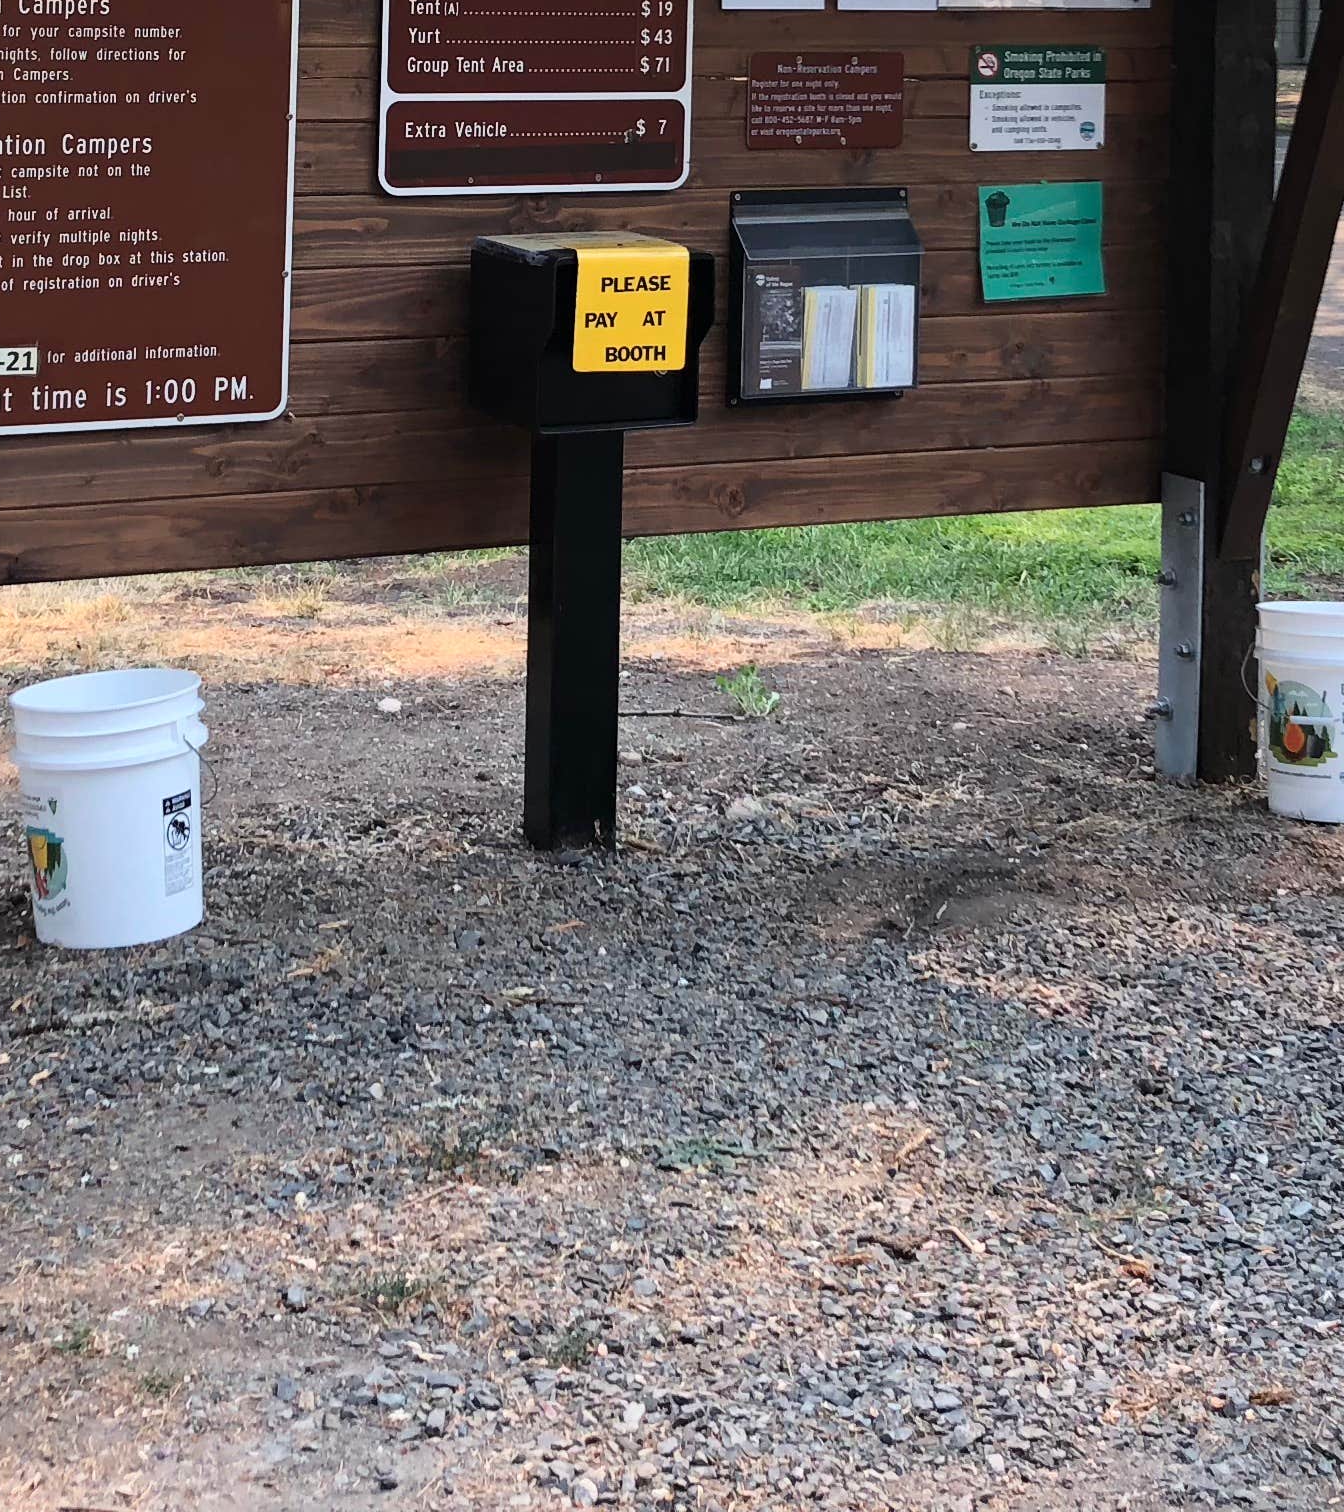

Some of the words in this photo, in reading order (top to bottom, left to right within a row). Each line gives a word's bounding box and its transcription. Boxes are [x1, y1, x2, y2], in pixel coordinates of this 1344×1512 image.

[409, 0, 440, 15] Tent
[444, 2, 459, 16] (A)
[641, 0, 651, 18] $
[659, 1, 673, 16] 19
[3, 24, 21, 37] for
[30, 27, 59, 40] your
[68, 25, 125, 40] campsite
[409, 28, 440, 43] Yurt
[641, 28, 650, 46] $
[654, 29, 672, 44] 43
[50, 48, 87, 60] follow
[96, 48, 159, 61] directions
[169, 48, 186, 61] for
[1004, 51, 1044, 65] Smoking
[1046, 51, 1090, 62] Prohibited
[1093, 53, 1102, 62] in
[14, 68, 73, 83] Campers.
[407, 57, 449, 77] Group
[456, 57, 485, 72] Tent
[492, 57, 524, 72] Area
[640, 56, 649, 74] $
[655, 57, 669, 72] 71
[777, 64, 842, 74] Non-Reservation
[845, 65, 877, 75] Campers
[1003, 68, 1036, 82] Oregon
[1038, 68, 1062, 79] State
[1065, 68, 1091, 79] Parks
[35, 91, 116, 103] confirmation
[126, 93, 139, 103] on
[149, 90, 196, 103] driver's
[405, 122, 446, 138] Extra
[455, 122, 507, 137] Vehicle
[636, 119, 646, 137] $
[659, 120, 667, 134] 7
[62, 134, 152, 159] Campers
[11, 165, 69, 180] campsite
[78, 164, 98, 177] not
[107, 166, 121, 176] on
[131, 164, 150, 176] the
[3, 186, 30, 198] List.
[8, 209, 37, 221] hour
[46, 208, 58, 221] of
[10, 231, 50, 247] verify
[59, 230, 110, 245] multiple
[120, 229, 161, 245] nights.
[12, 255, 23, 267] in
[33, 254, 53, 267] the
[62, 253, 89, 268] drop
[99, 253, 120, 265] box
[129, 251, 141, 264] at
[151, 251, 174, 264] this
[182, 250, 228, 266] station.
[1, 278, 14, 291] of
[23, 275, 99, 294] registration
[108, 274, 122, 288] on
[131, 272, 180, 287] driver's
[600, 273, 672, 294] PLEASE
[584, 311, 618, 330] PAY
[643, 310, 666, 327] AT
[48, 351, 65, 363] for
[74, 347, 136, 362] additional
[145, 344, 219, 359] information.
[604, 345, 668, 363] BOOTH
[32, 385, 87, 410] time
[107, 382, 126, 409] is
[146, 378, 195, 404] 1:00
[215, 376, 255, 401] PM.
